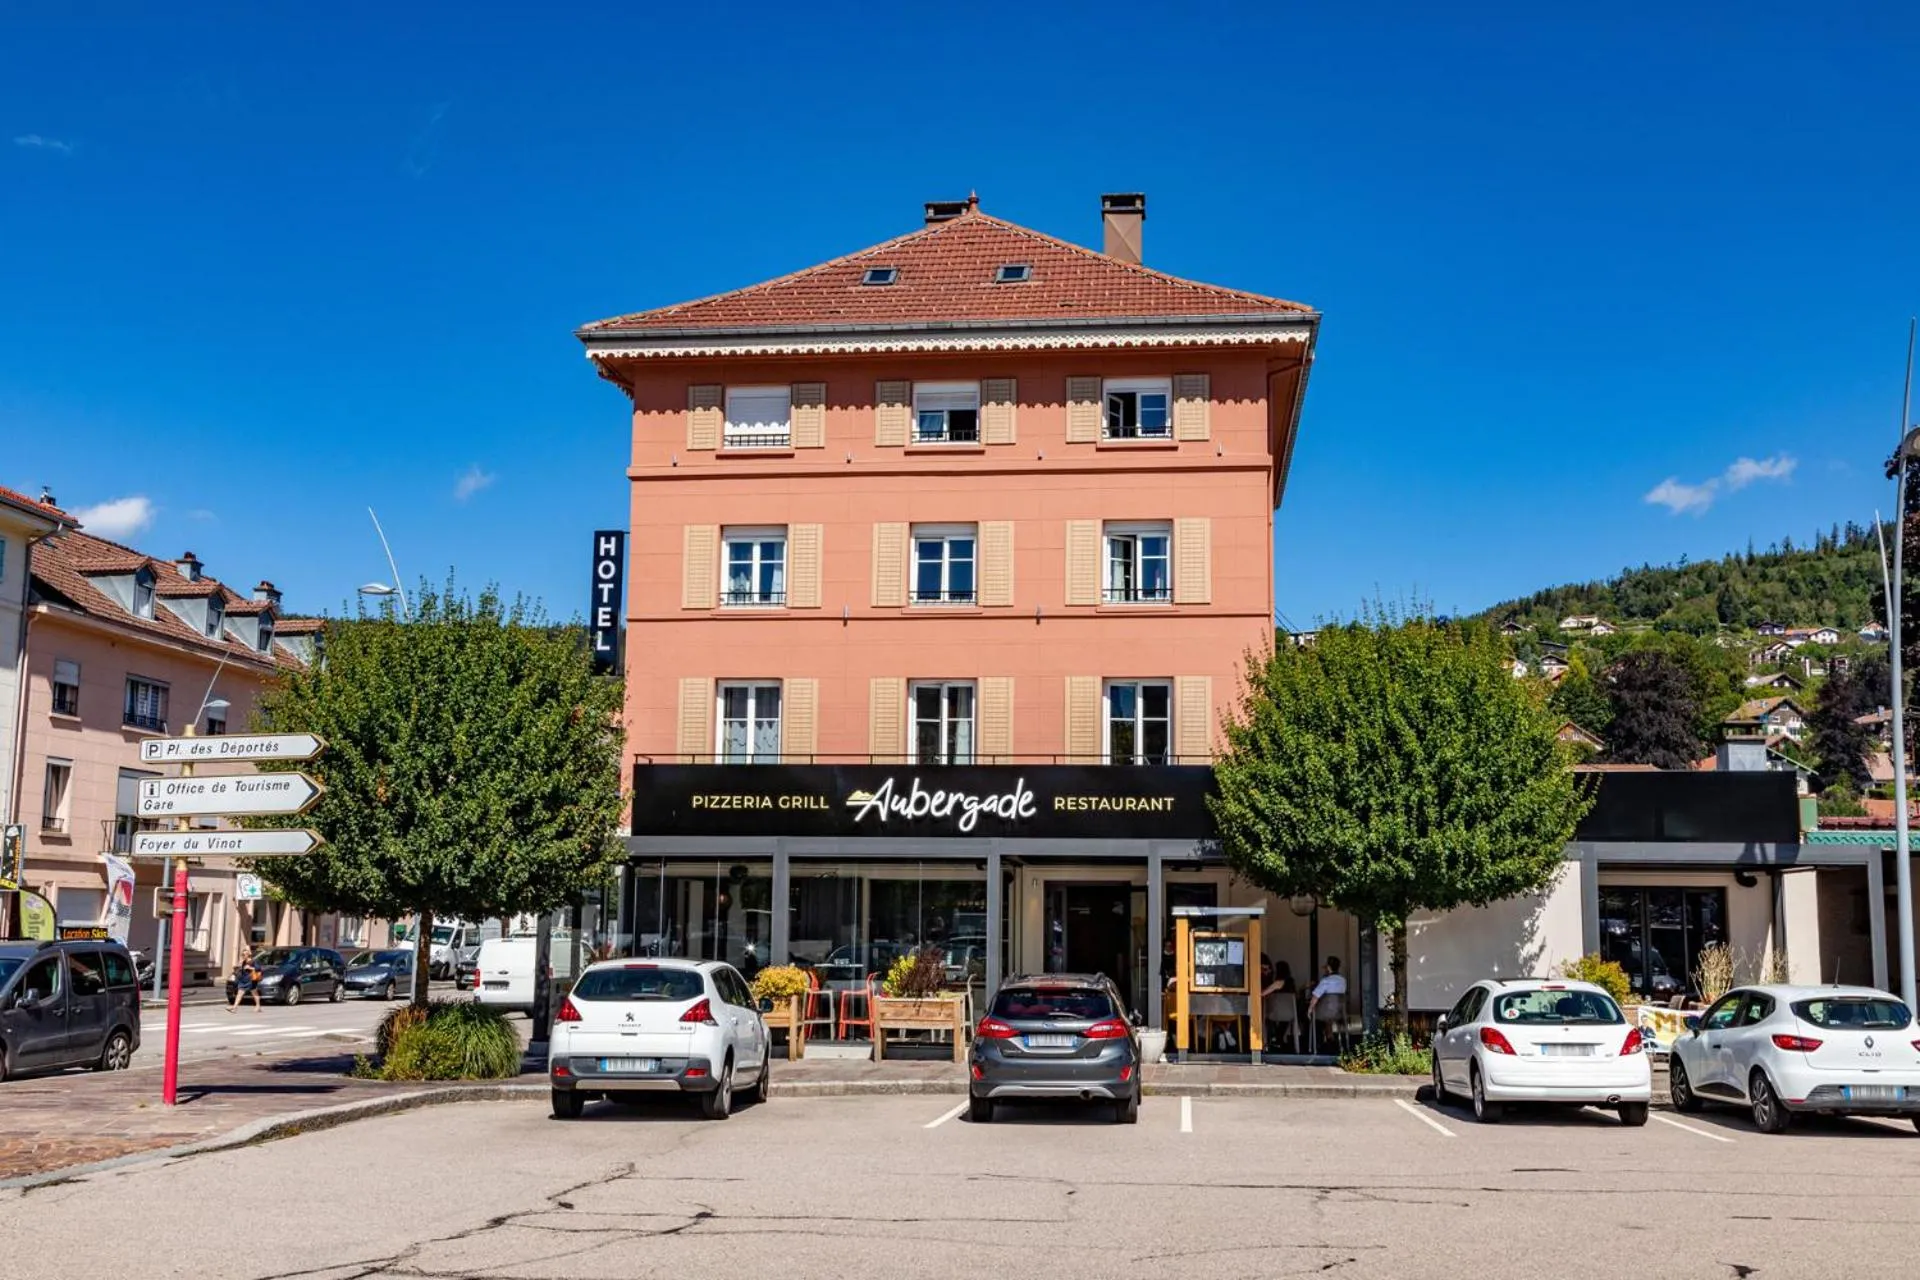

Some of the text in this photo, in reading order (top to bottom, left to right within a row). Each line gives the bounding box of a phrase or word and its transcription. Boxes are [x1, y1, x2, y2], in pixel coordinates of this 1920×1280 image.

[596, 536, 616, 650] HOTEL
[191, 743, 212, 754] des
[220, 741, 279, 755] Déportés
[167, 783, 205, 795] Office
[212, 781, 226, 793] de
[235, 779, 290, 793] Tourisme
[144, 799, 174, 810] Gare
[692, 795, 829, 809] PIZZERIA GRILL
[851, 777, 1036, 832] Aubergade
[1053, 797, 1175, 811] RESTAURANT
[140, 837, 243, 851] Foyer du Vinot
